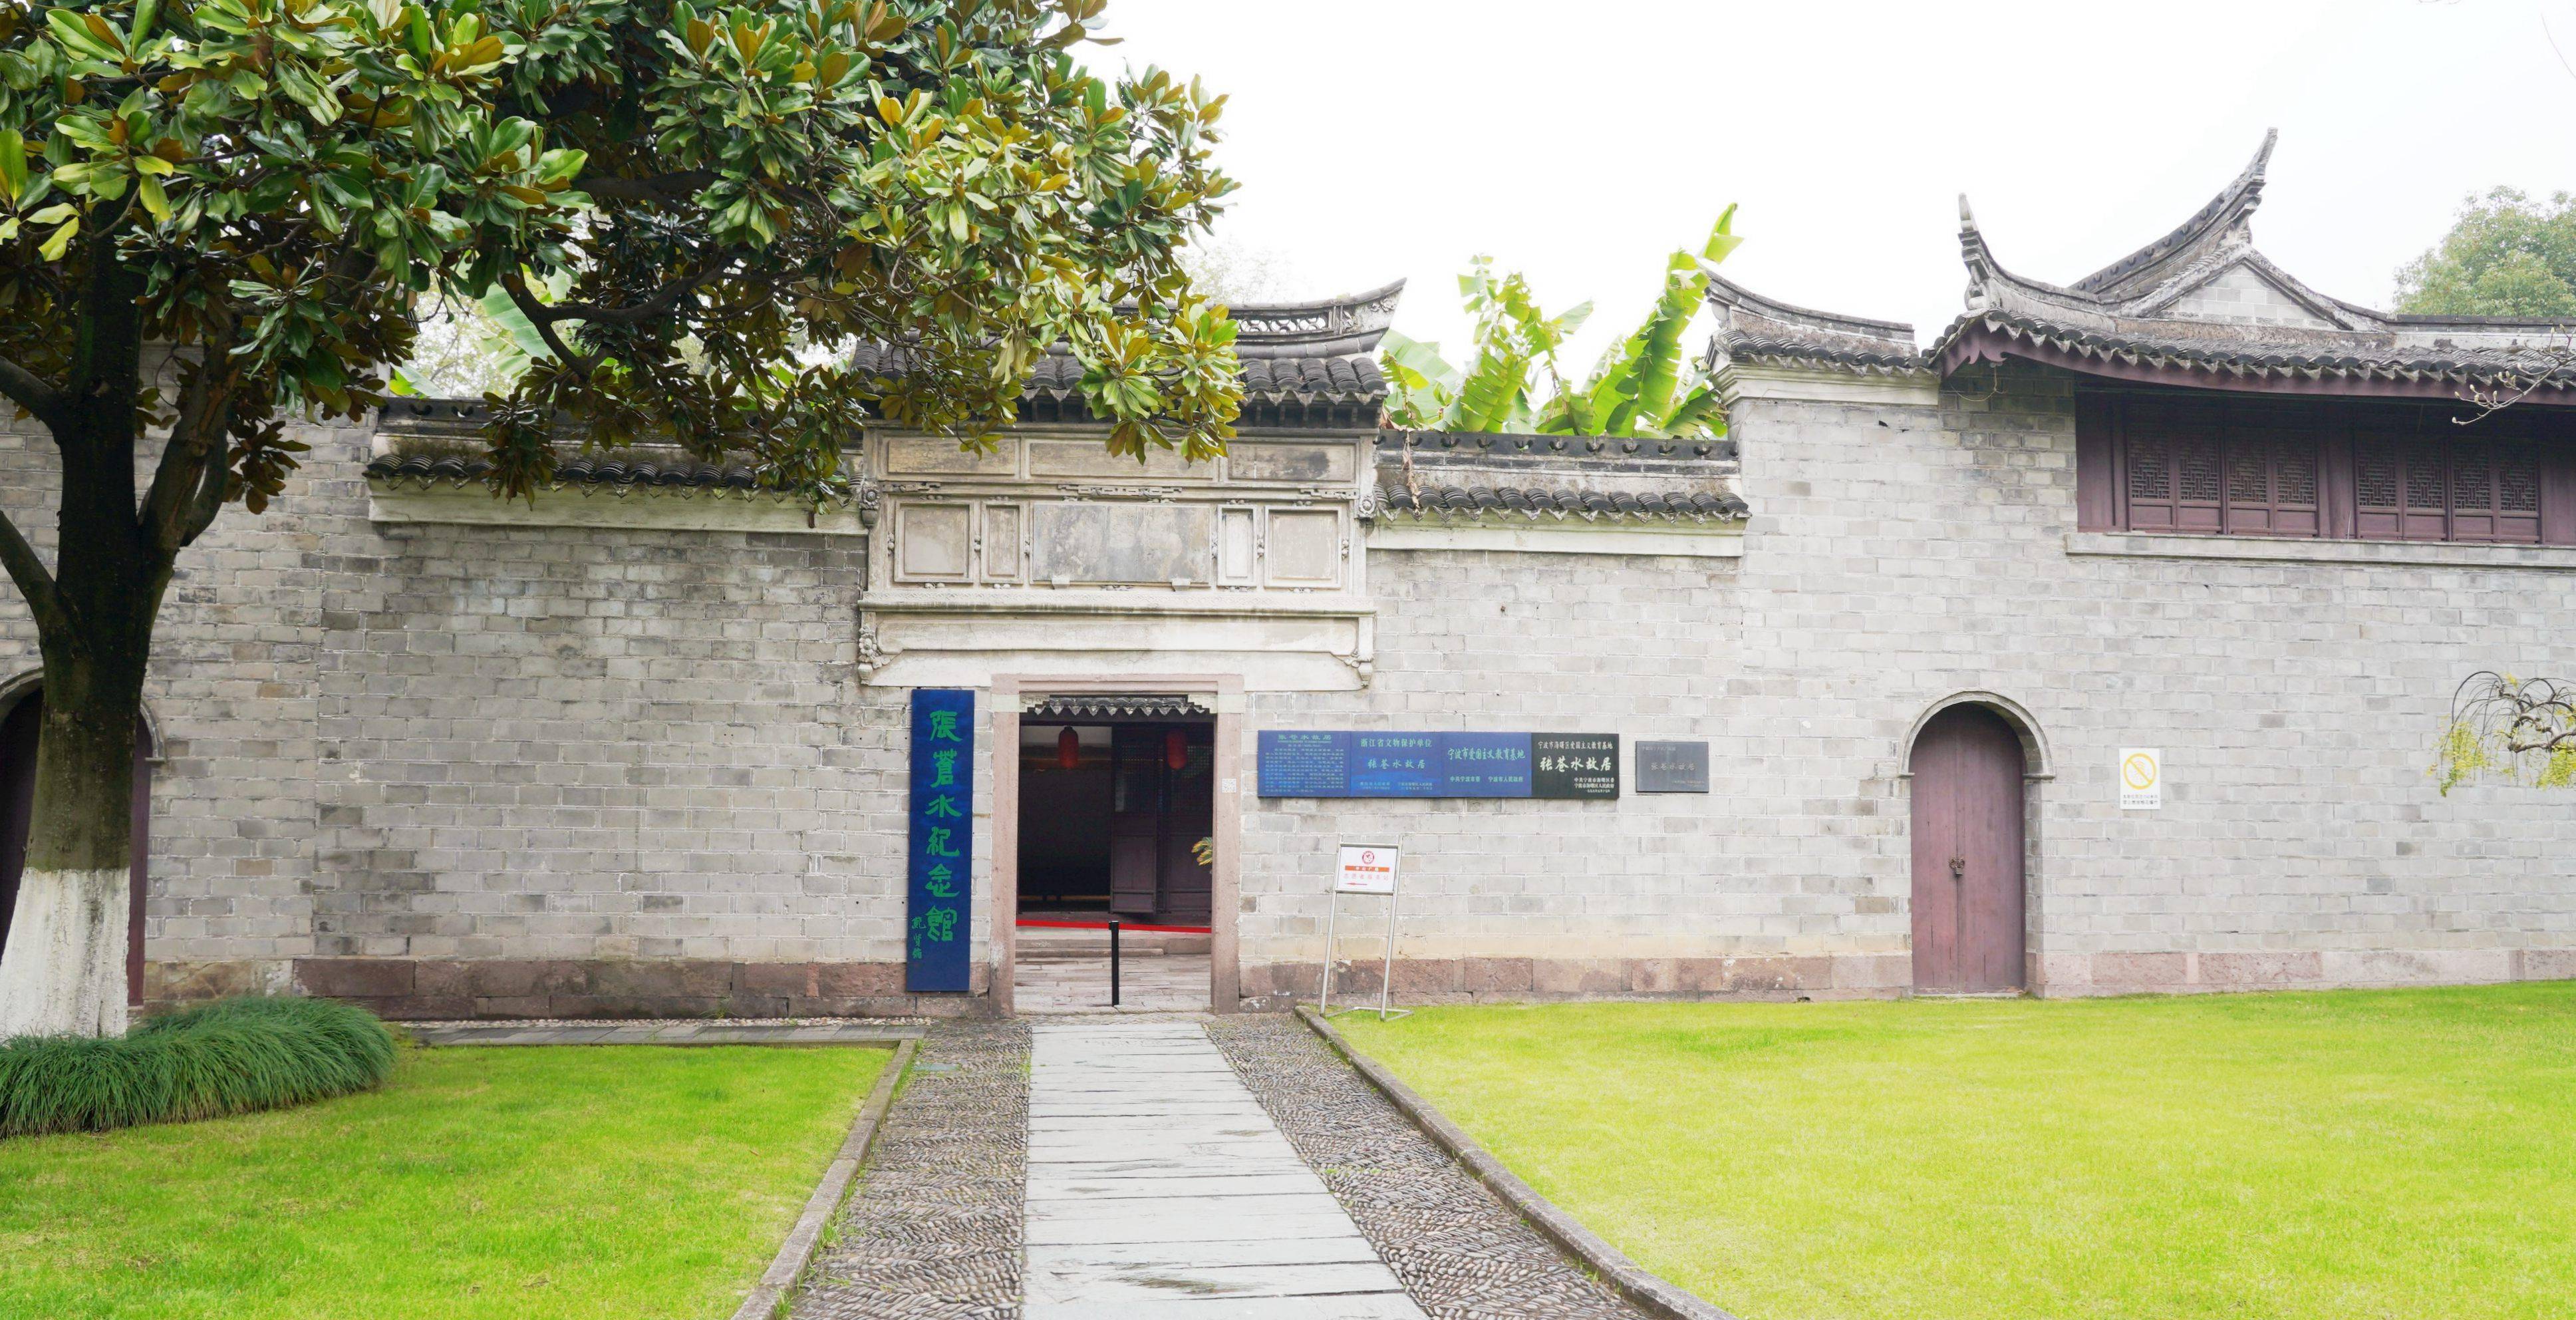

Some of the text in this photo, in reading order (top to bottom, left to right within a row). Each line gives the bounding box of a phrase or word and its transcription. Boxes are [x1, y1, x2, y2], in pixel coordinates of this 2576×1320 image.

[1361, 738, 1433, 748] 浙江省文物保护单位
[1538, 741, 1614, 750] 宁波市海曙区爱国主义教育基地
[1447, 746, 1526, 760] 宁波市爱国主义教育基地
[1367, 758, 1425, 770] 张苍水故居
[1540, 755, 1612, 772] 张苍水故居
